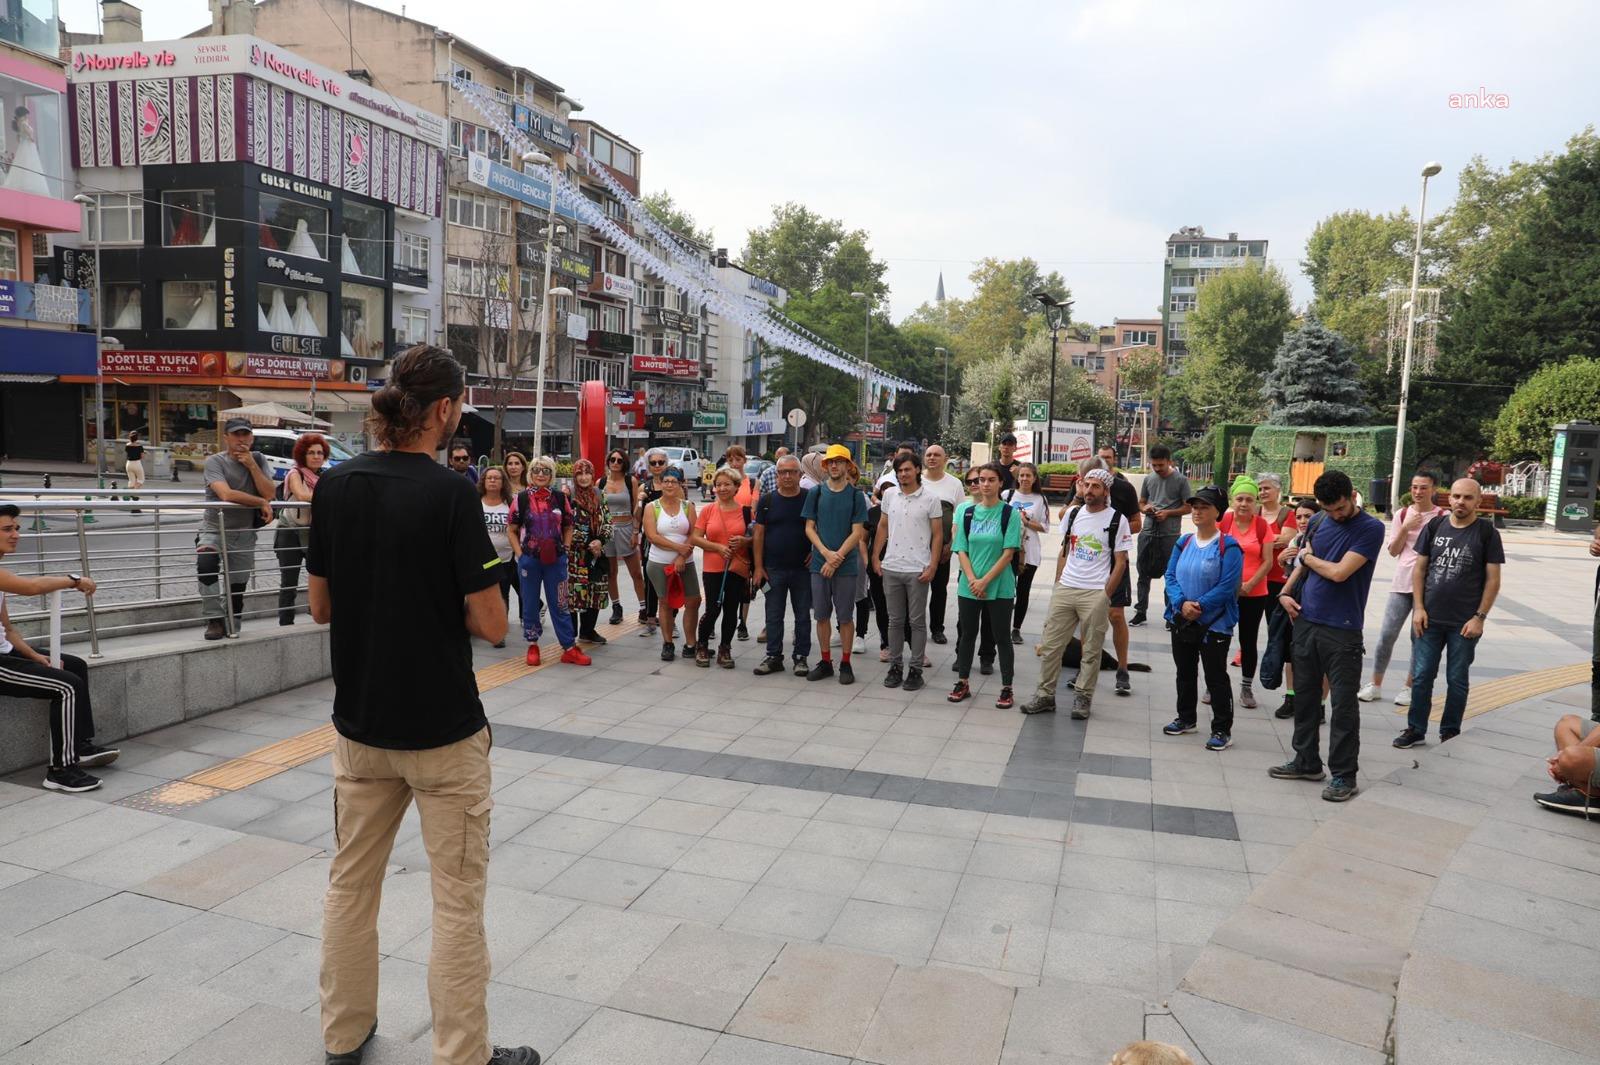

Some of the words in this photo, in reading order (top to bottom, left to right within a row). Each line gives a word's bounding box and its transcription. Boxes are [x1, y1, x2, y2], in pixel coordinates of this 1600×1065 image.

[87, 52, 149, 70] Nouvelle
[153, 50, 176, 67] vie
[264, 51, 321, 89] Nouvelle
[322, 78, 342, 97] vie
[224, 247, 235, 328] GÜLSE
[271, 334, 322, 356] GÜLSE
[107, 352, 157, 364] DÖRTLER
[160, 354, 198, 366] YUFKA
[248, 356, 265, 368] HAS
[267, 356, 301, 370] DÖRTLER
[301, 360, 329, 372] YUFKA
[1434, 536, 1453, 547] IST
[1441, 547, 1461, 558] AN
